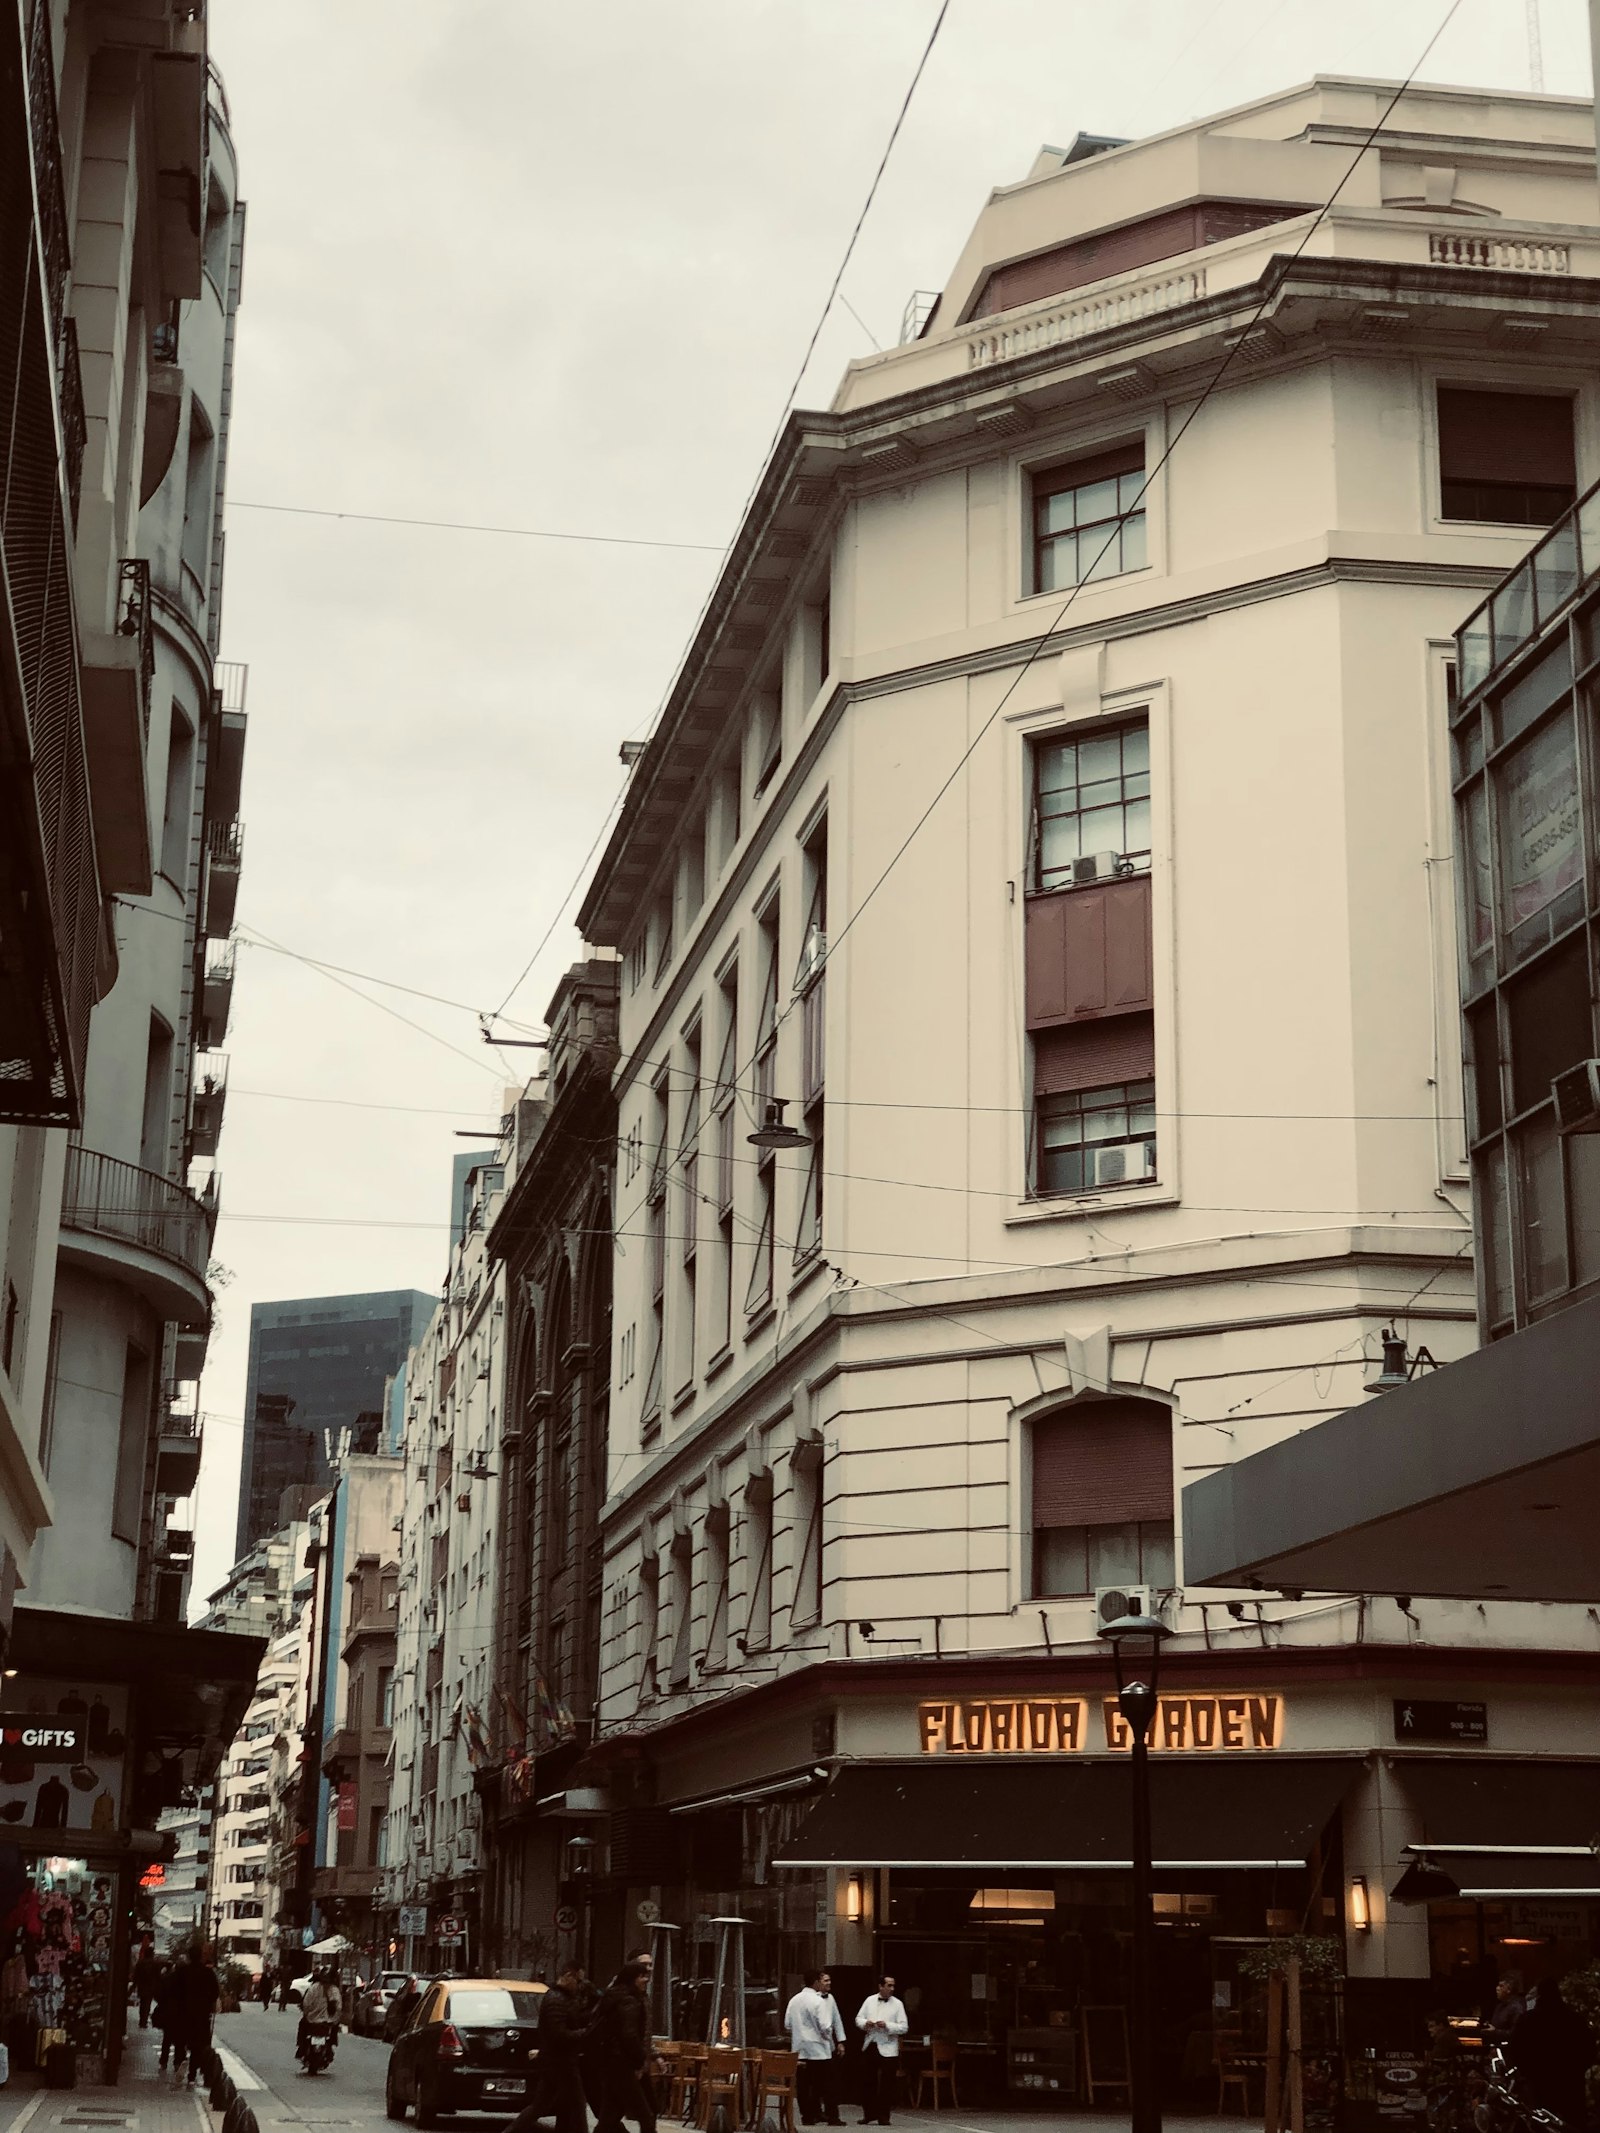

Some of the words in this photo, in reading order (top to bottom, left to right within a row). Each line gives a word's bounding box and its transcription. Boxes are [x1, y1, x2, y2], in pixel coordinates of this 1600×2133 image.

[1457, 1703, 1484, 1712] Florida
[918, 1702, 1081, 1751] FLORIDA
[1102, 1699, 1277, 1748] GRDEN
[559, 1911, 575, 1924] 20
[1519, 1905, 1580, 1920] Delivery
